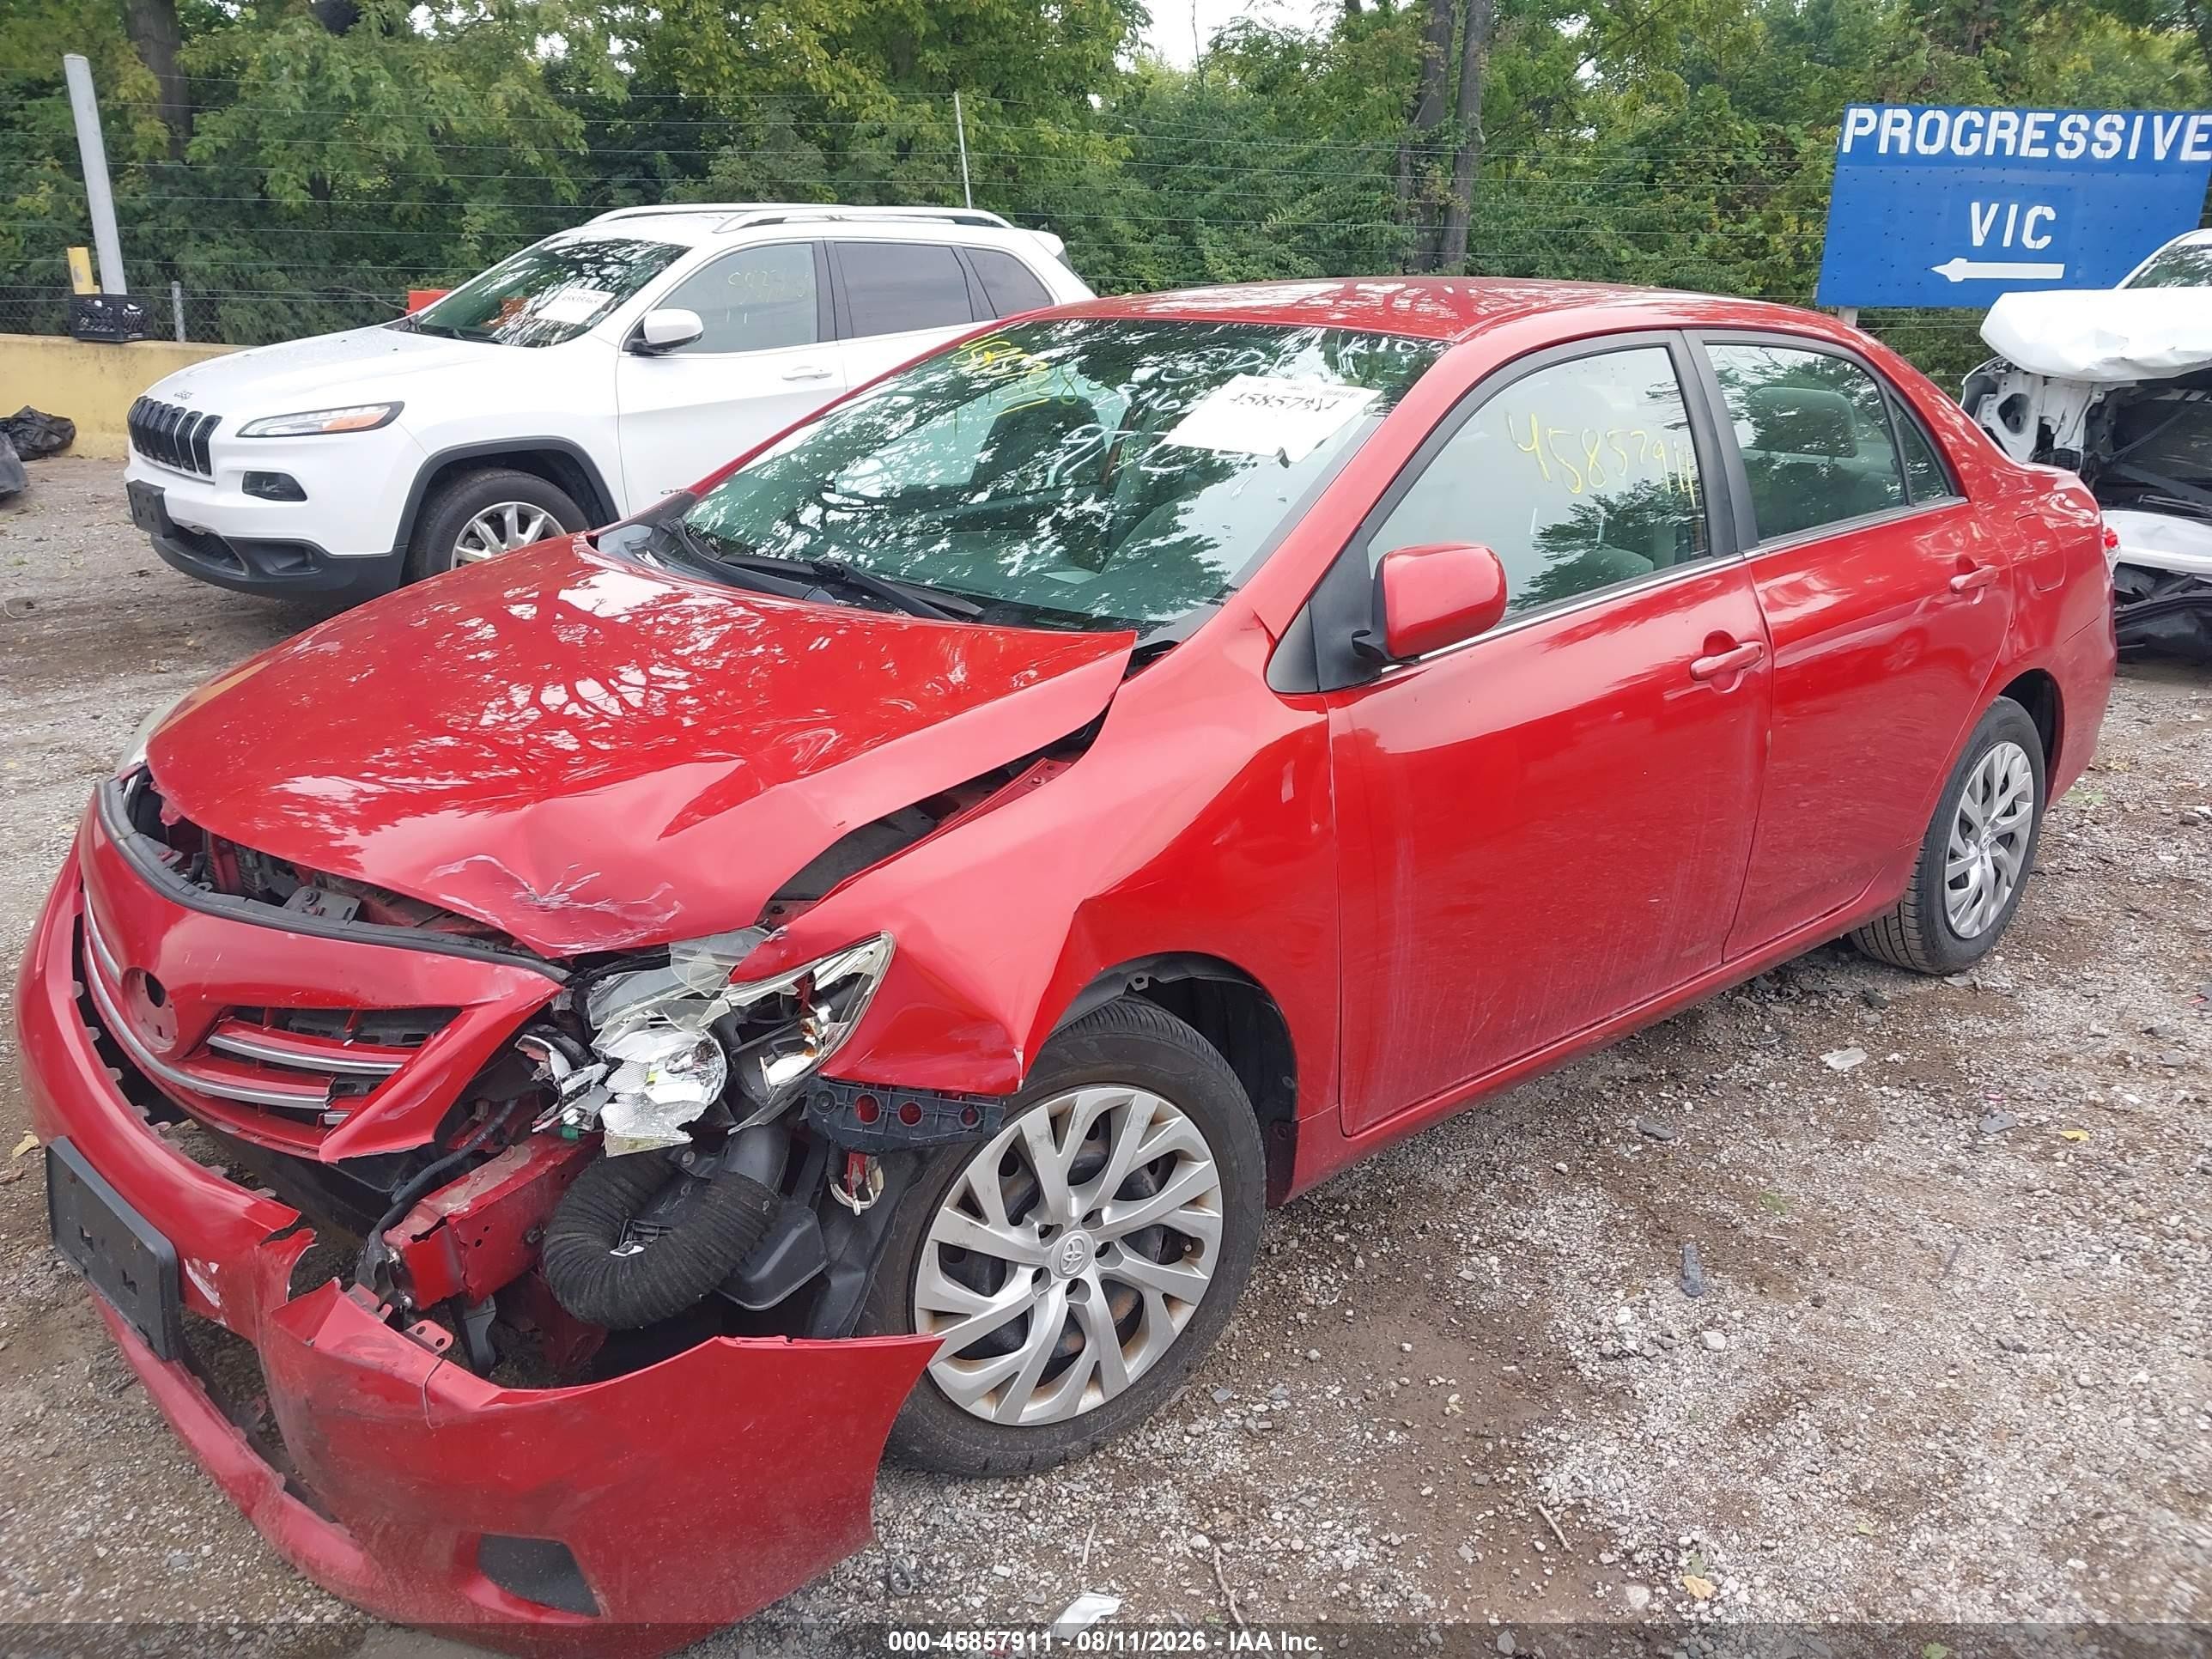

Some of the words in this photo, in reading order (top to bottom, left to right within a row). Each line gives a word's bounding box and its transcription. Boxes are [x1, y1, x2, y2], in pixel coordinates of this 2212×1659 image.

[1842, 107, 2212, 161] PROGRESSIVE
[1970, 201, 2057, 250] VIC
[1506, 412, 1697, 509] 45857911
